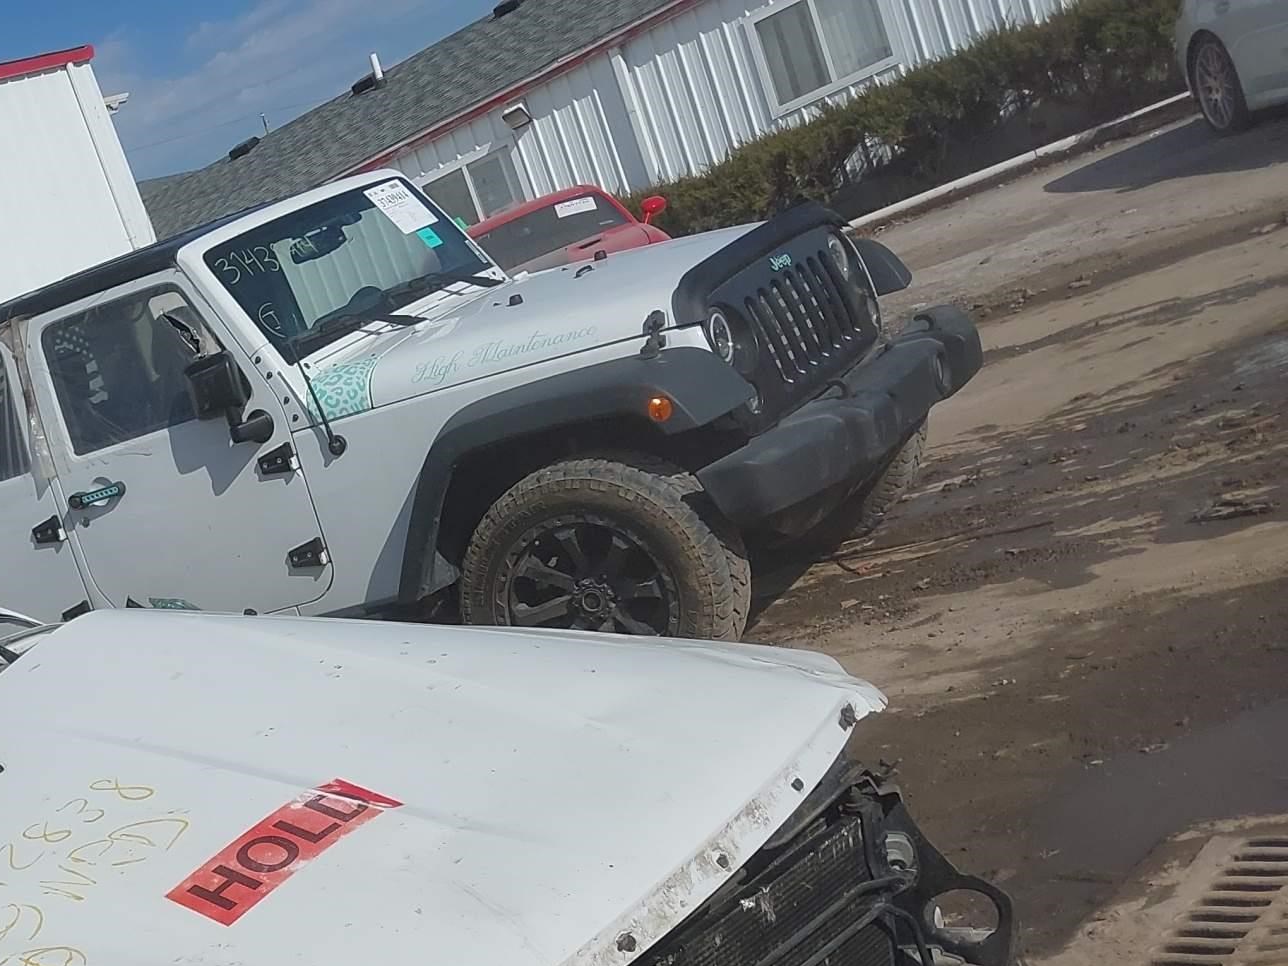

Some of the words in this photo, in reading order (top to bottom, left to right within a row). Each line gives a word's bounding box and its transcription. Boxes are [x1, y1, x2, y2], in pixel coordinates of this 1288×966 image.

[769, 253, 792, 271] Jeep
[412, 351, 464, 385] High
[467, 325, 598, 367] Maintenance
